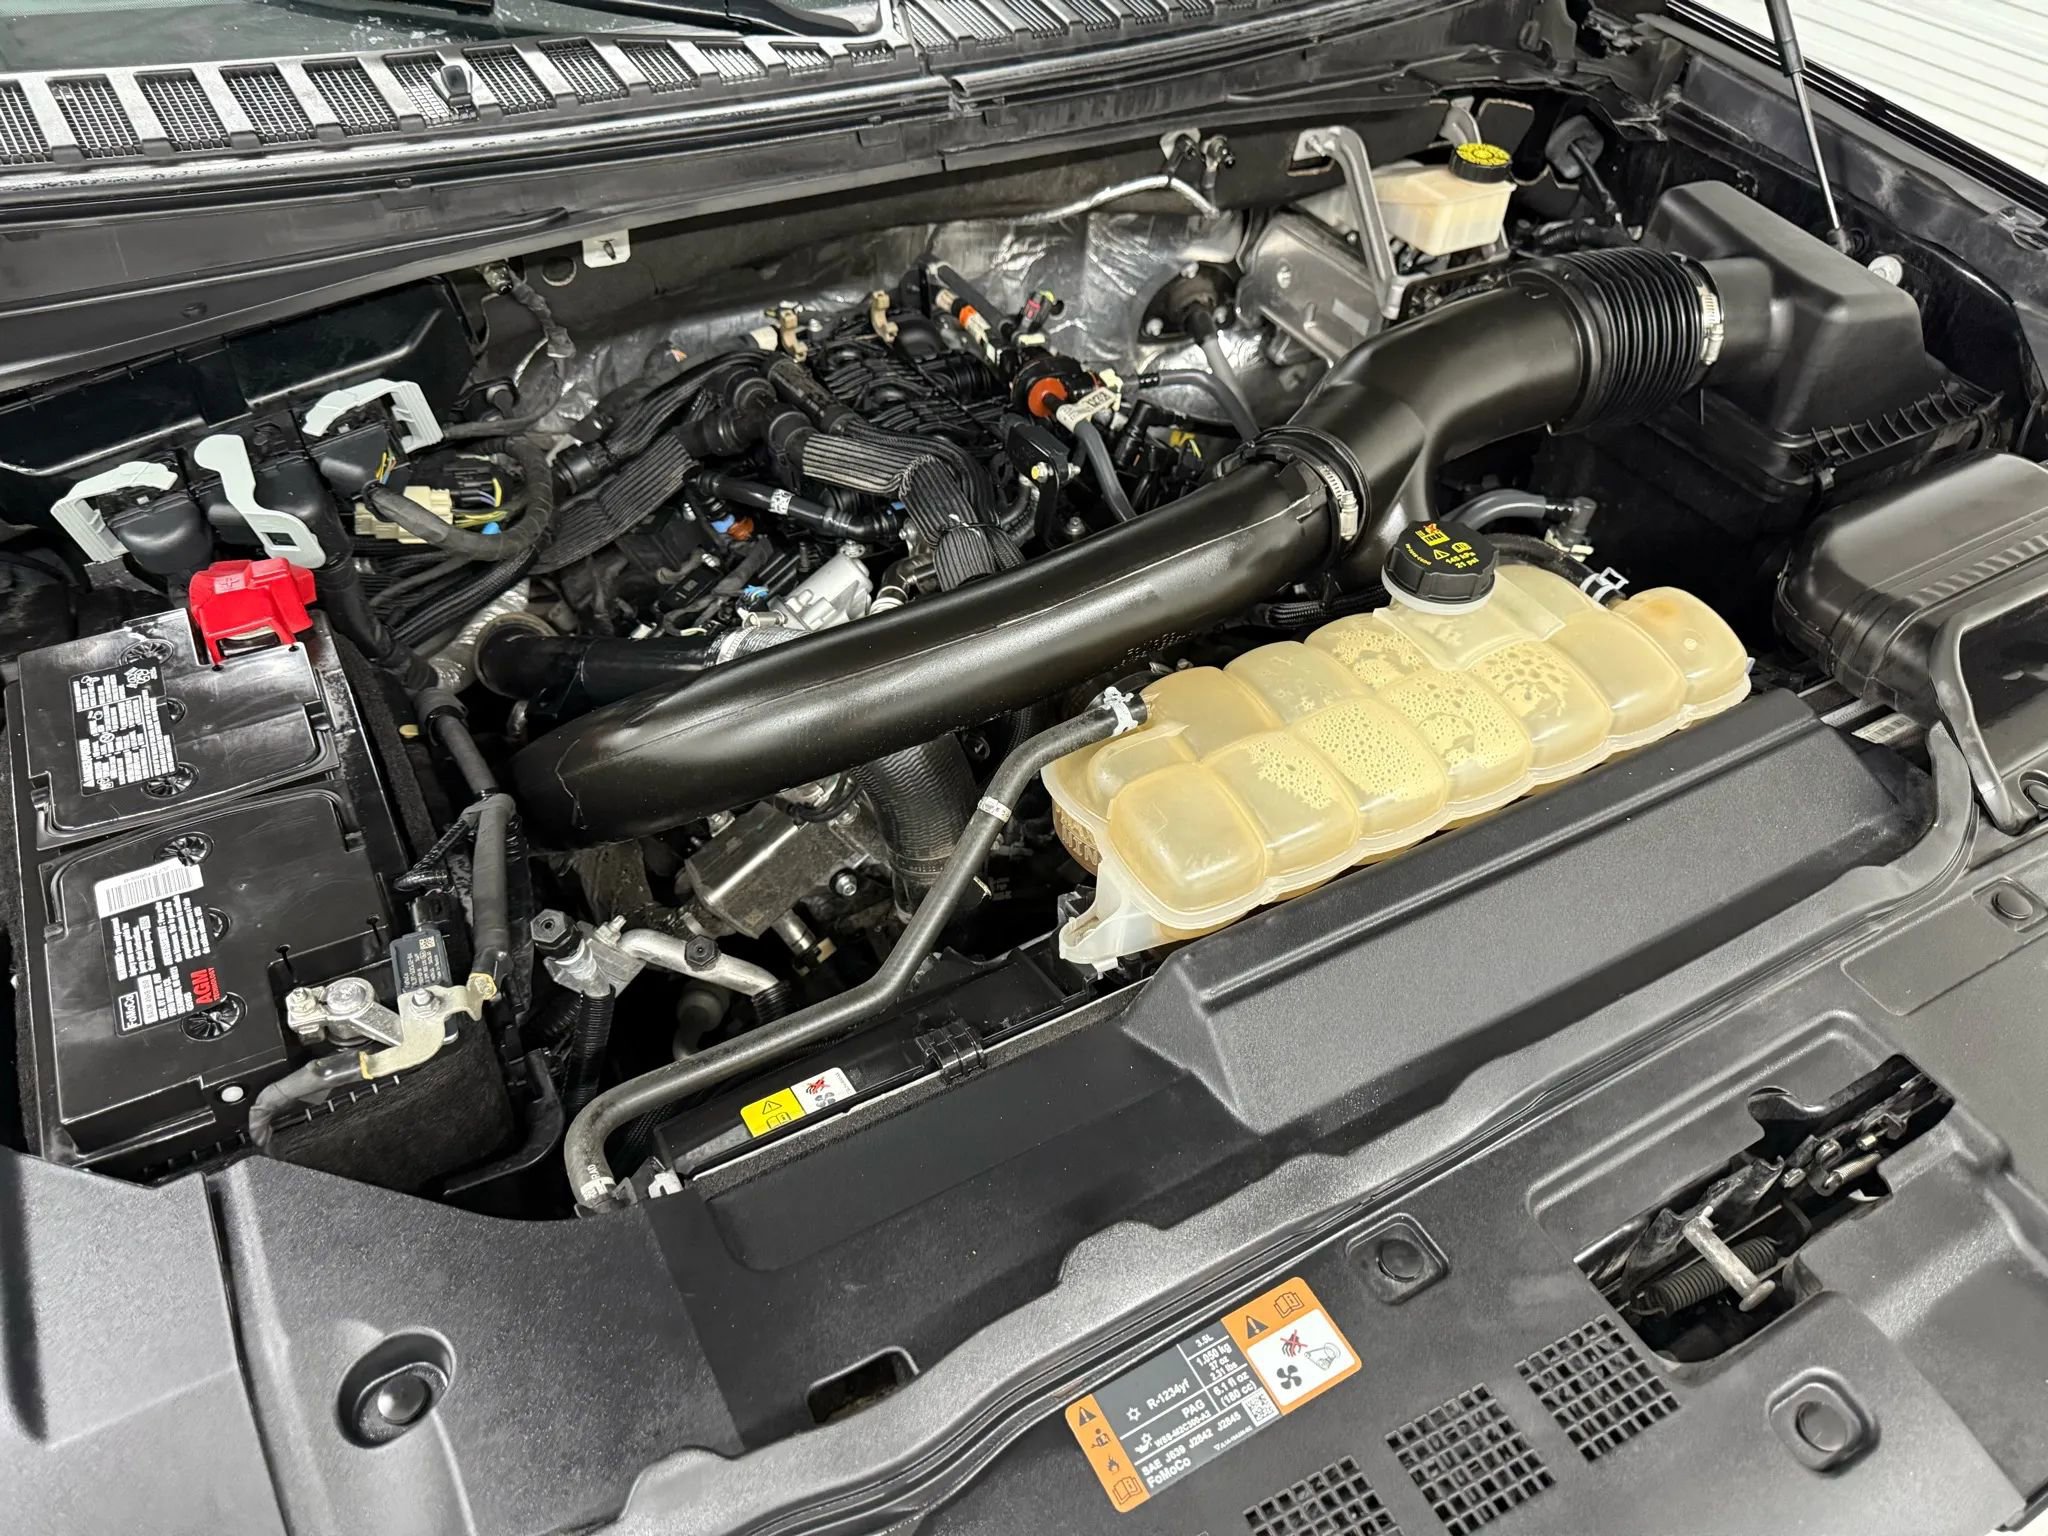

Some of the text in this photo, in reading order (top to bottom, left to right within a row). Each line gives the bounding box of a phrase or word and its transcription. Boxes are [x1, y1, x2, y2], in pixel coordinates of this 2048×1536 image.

[190, 969, 213, 1004] AGM
[207, 967, 220, 1001] TECHNOLOGY
[124, 994, 139, 1029] FoMoCo
[1195, 1333, 1214, 1348] 3.5L
[1196, 1342, 1233, 1367] 1.050 kg
[1208, 1355, 1230, 1371] 37 oz
[1209, 1361, 1238, 1381] 2.31 lbs
[1146, 1377, 1190, 1410] R-1234yf
[1213, 1371, 1250, 1396] 6.1 fl oz
[1220, 1379, 1258, 1408] (180 cc)
[1181, 1398, 1206, 1419] PAG
[1141, 1458, 1163, 1476] SAE
[1188, 1428, 1214, 1449] J2842
[1217, 1411, 1242, 1432] J2845
[1146, 1457, 1192, 1489] FoMoCo
